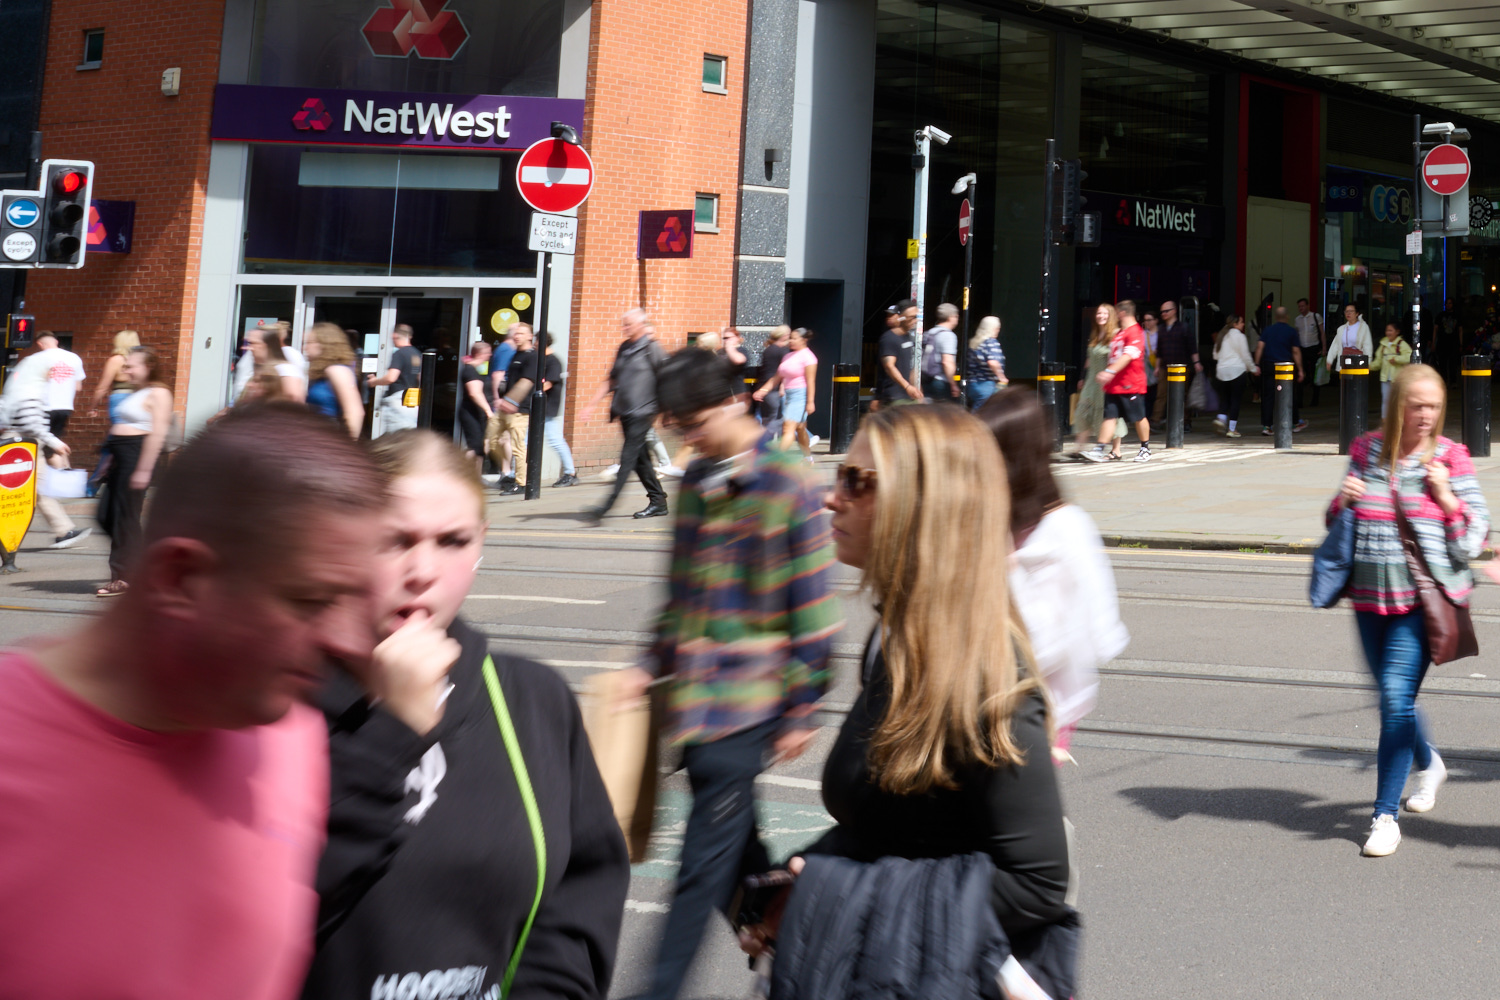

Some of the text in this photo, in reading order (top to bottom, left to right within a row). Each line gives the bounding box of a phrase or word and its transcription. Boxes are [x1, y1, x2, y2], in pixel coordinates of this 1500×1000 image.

[343, 99, 512, 139] NatWest
[1135, 200, 1196, 232] NatWest
[541, 217, 569, 229] Except
[534, 228, 557, 238] tms
[6, 239, 33, 247] Except
[540, 240, 565, 249] cycles
[1, 491, 26, 501] Except
[19, 499, 31, 507] and
[1, 509, 24, 518] cycles
